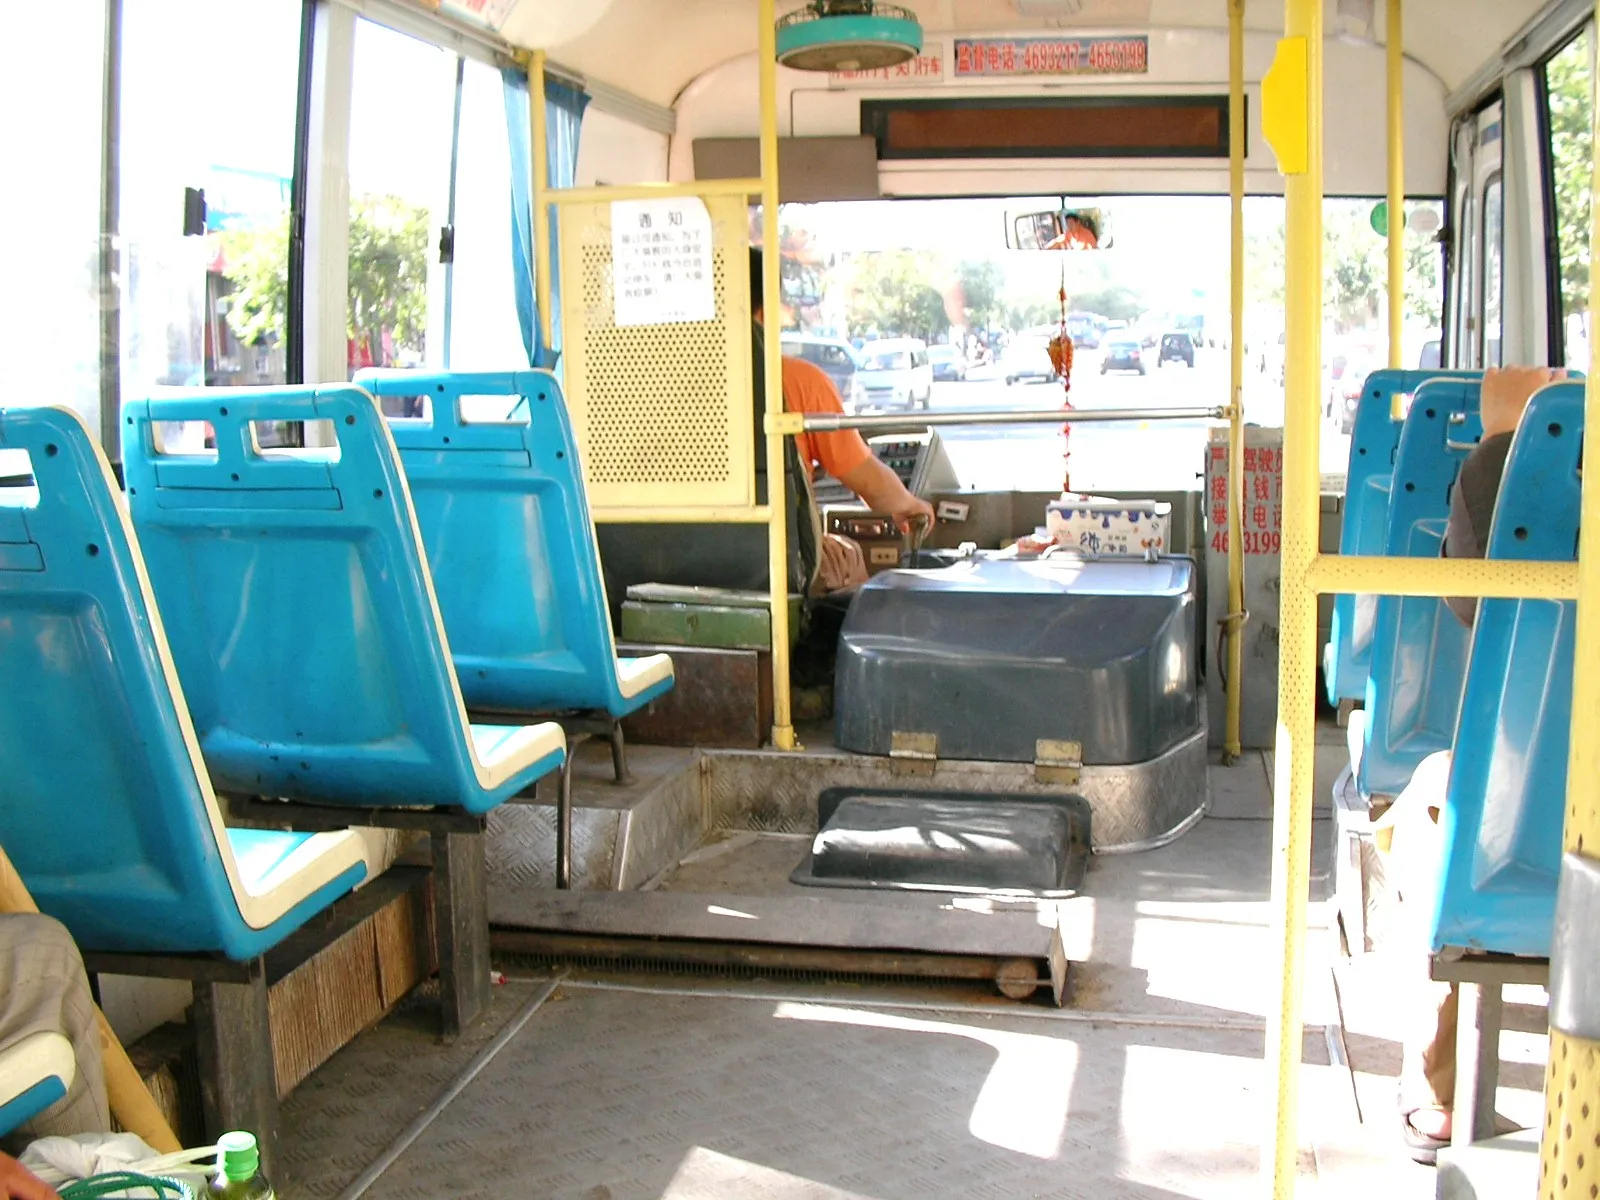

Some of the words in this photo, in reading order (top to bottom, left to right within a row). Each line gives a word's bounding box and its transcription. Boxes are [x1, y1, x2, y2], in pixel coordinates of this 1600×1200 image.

[958, 42, 1016, 73] 监督电话
[1024, 41, 1080, 72] 4693217
[1089, 40, 1146, 70] 4653199
[1210, 447, 1282, 472] 严驾驶
[1211, 474, 1282, 500] 接钱
[1211, 530, 1282, 554] 463199
